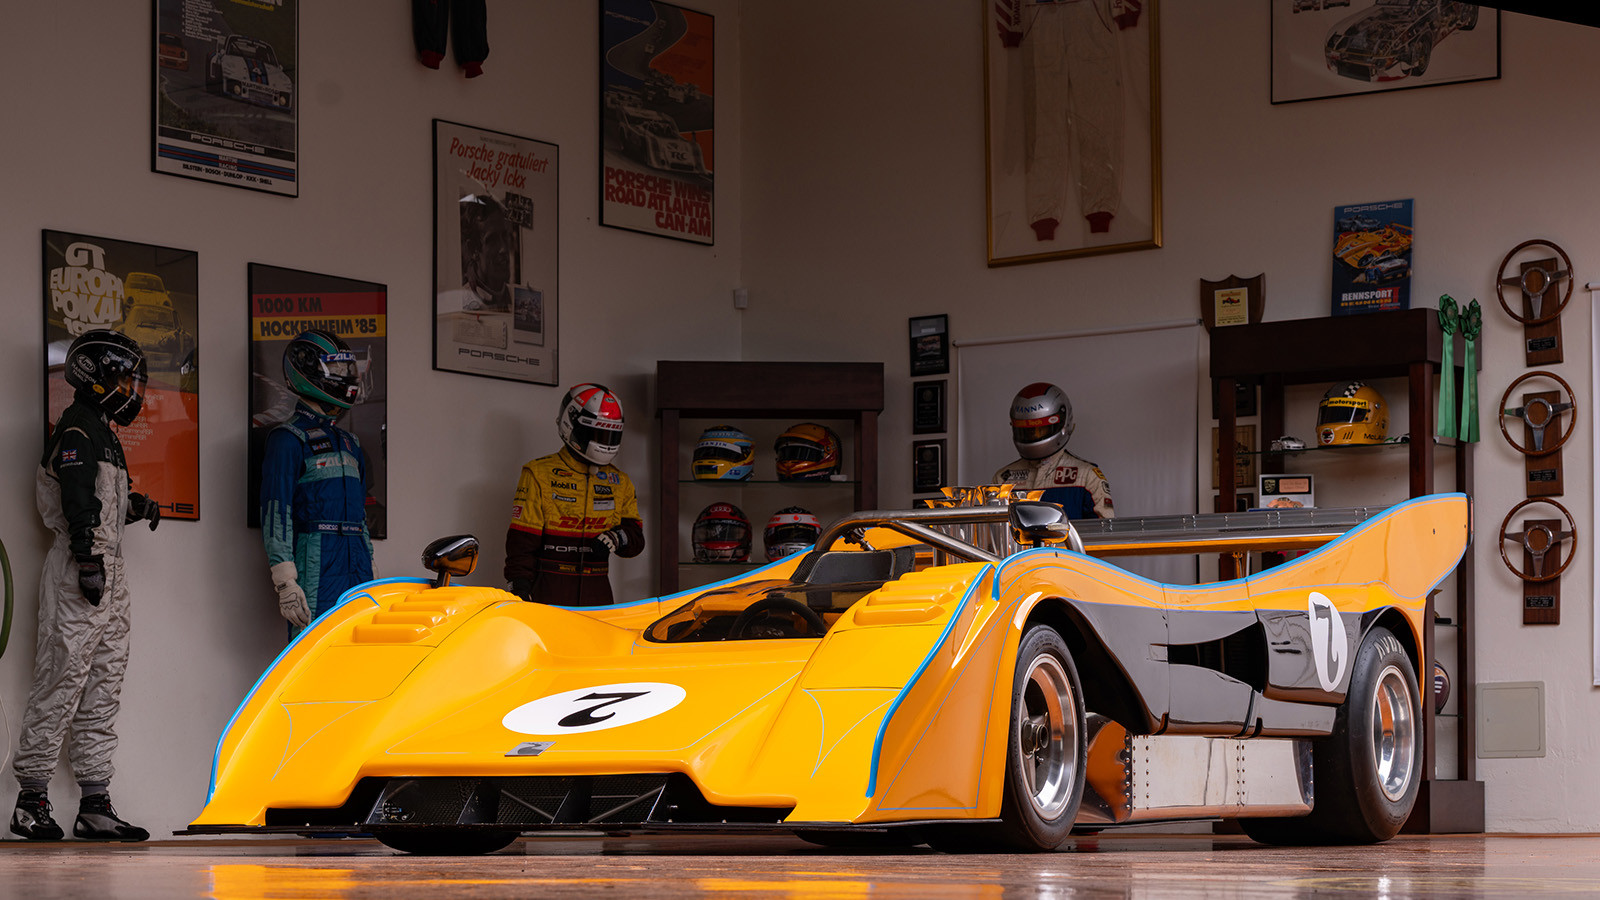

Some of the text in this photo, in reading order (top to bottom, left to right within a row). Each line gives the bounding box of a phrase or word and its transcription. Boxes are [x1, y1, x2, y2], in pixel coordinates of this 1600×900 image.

[190, 133, 265, 155] PORSCHE
[450, 137, 494, 162] Porsche
[495, 151, 549, 173] gratuliert
[224, 171, 243, 180] DUNLOP
[259, 178, 273, 186] SHELL
[466, 161, 527, 189] Jacky Ickx
[605, 166, 711, 203] PORSCHE WINS
[605, 183, 711, 220] ROAD ATLANTA
[1343, 202, 1404, 214] PORSCHE
[65, 241, 106, 271] GT
[50, 266, 125, 300] EUROPA
[1341, 289, 1393, 302] RENNSPORT
[51, 289, 122, 324] POKAL
[257, 296, 323, 314] 1000 KM
[260, 319, 354, 336] HOCKENHEIM
[458, 348, 541, 366] PORSCHE
[1329, 399, 1367, 407] motorsport
[1055, 467, 1078, 483] PPG
[551, 480, 570, 489] Mobil
[559, 516, 607, 529] DHL
[543, 544, 593, 553] PORS
[1312, 601, 1339, 684] 7
